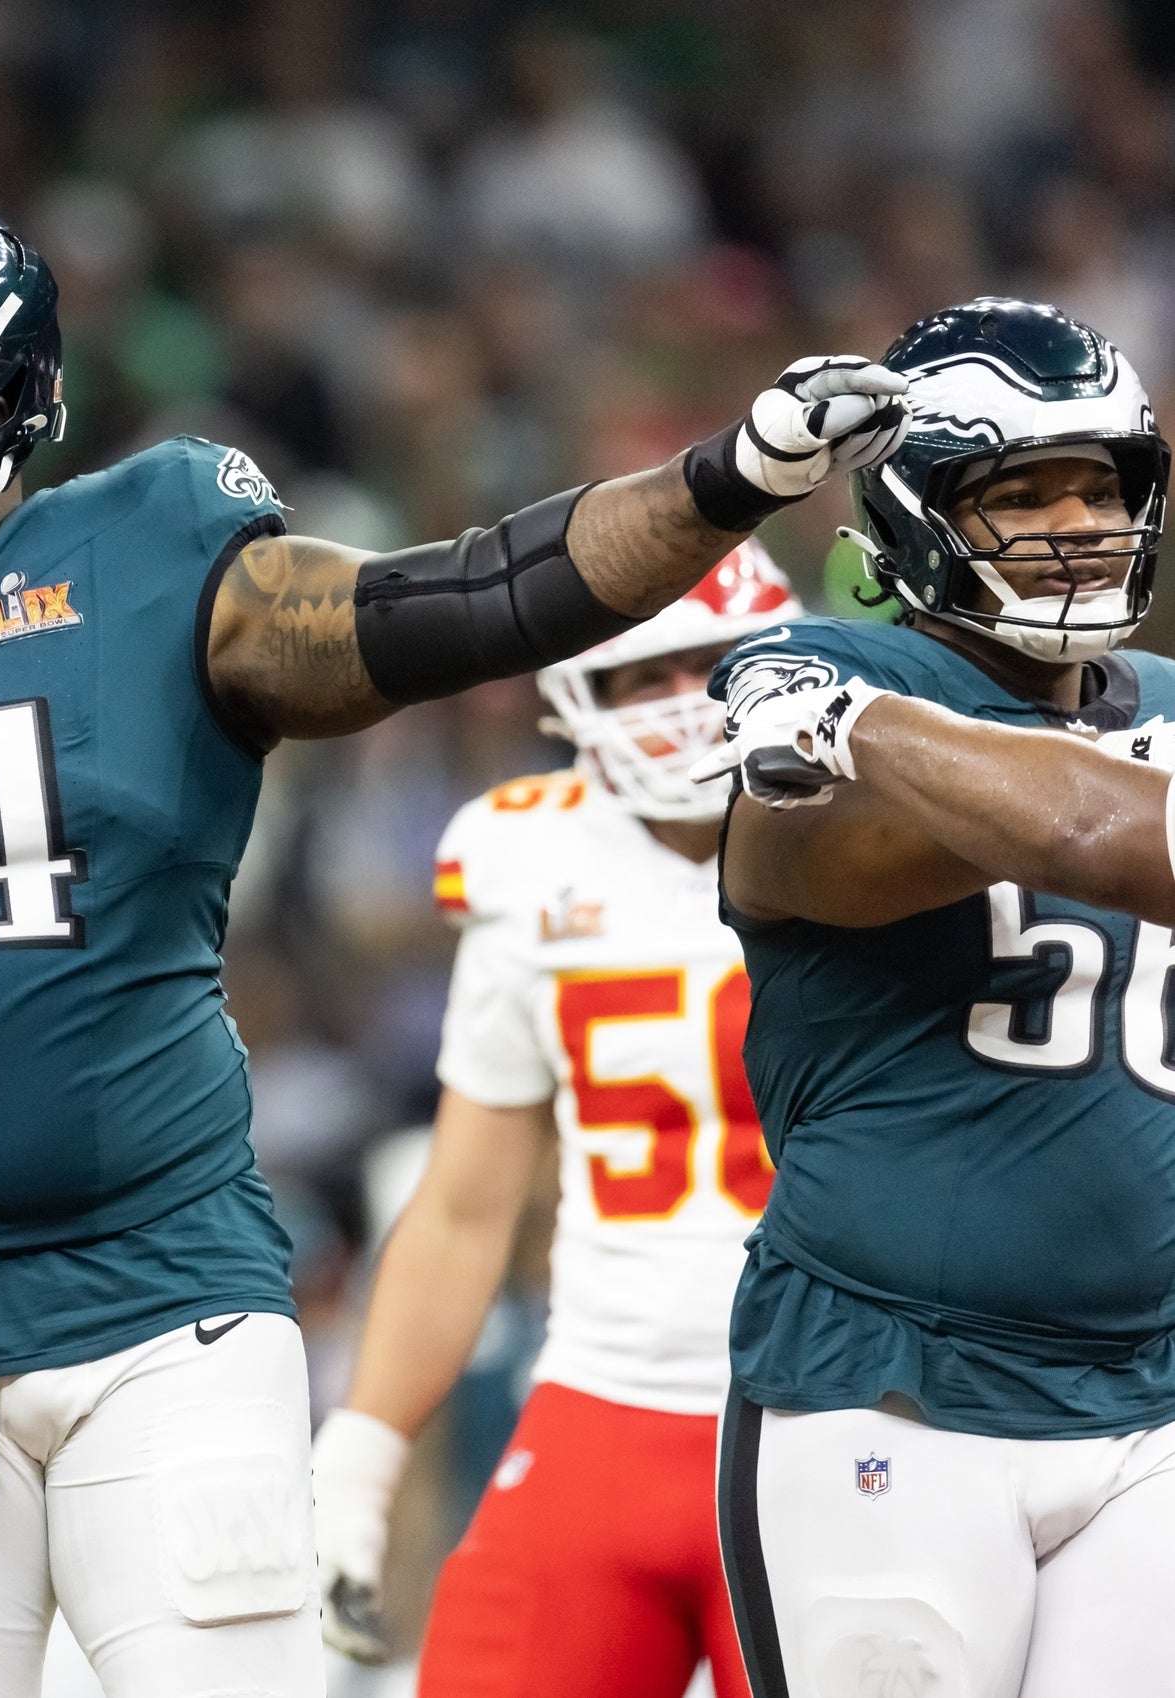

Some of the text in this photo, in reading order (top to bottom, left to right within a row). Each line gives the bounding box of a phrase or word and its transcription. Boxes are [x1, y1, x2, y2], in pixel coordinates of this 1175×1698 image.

[0, 618, 71, 638] SUPER BOWL
[860, 1472, 886, 1491] NFL
